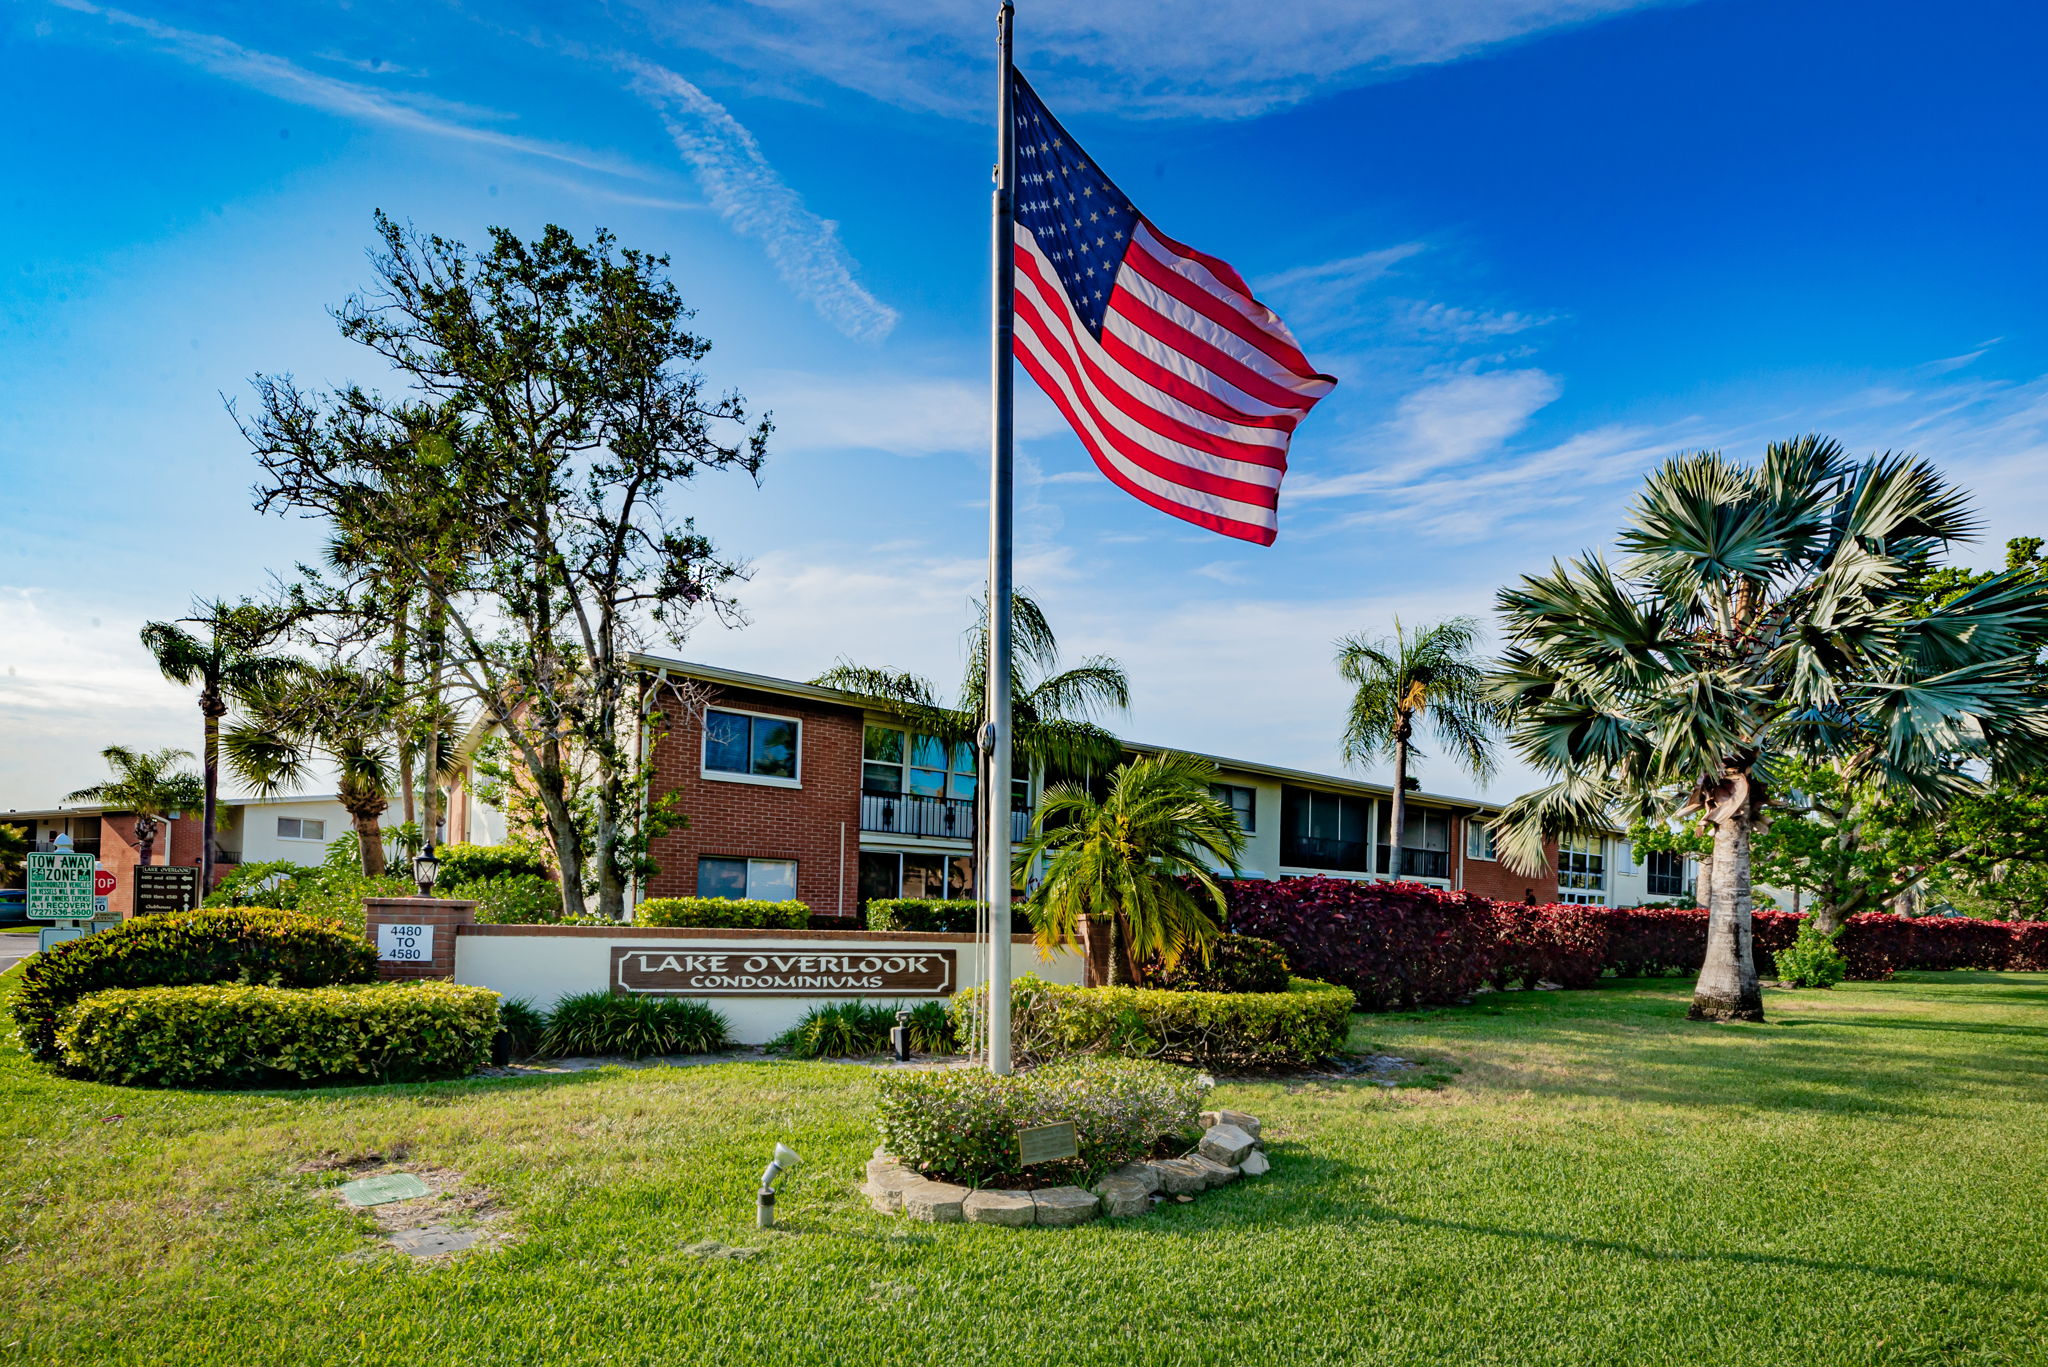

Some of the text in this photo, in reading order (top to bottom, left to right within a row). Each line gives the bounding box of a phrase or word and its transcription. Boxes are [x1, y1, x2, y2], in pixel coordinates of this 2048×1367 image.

[31, 855, 55, 868] TOW
[46, 868, 77, 881] ZONE
[95, 878, 115, 889] OP
[390, 926, 422, 937] 4480
[396, 937, 415, 948] TO
[389, 949, 421, 959] 4580
[638, 955, 929, 973] LAKE OVERLOOK
[690, 975, 883, 988] CONDOMINIUMS
